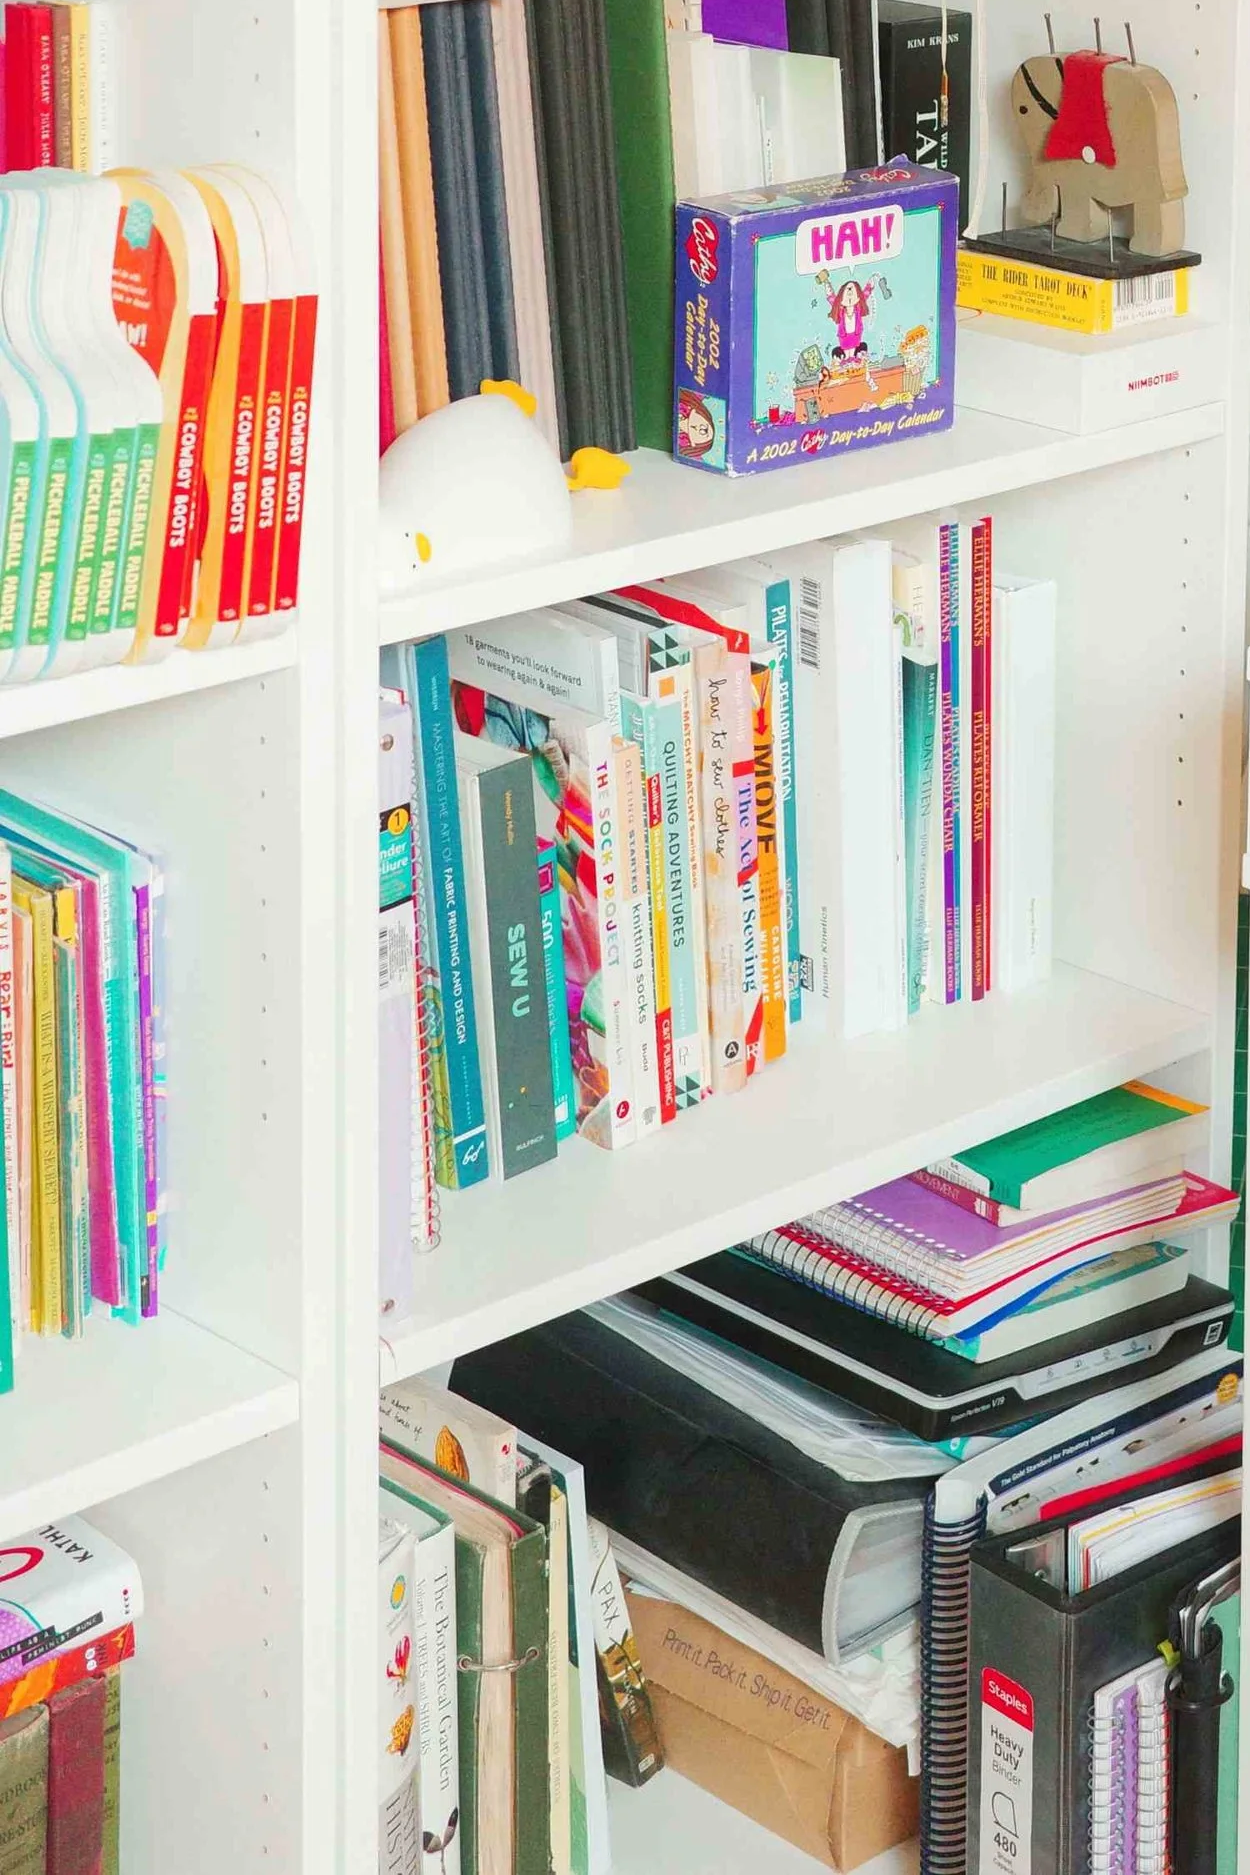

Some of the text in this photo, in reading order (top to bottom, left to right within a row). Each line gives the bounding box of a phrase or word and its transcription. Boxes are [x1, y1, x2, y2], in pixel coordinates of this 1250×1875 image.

[907, 37, 925, 50] KIM
[940, 131, 948, 169] WILD
[690, 217, 716, 287] Cathy
[811, 212, 895, 264] HAH!
[981, 263, 998, 280] THE
[1003, 267, 1029, 288] RIDER
[1033, 276, 1062, 295] TAROT
[1066, 283, 1089, 300] DECK
[684, 299, 696, 372] Calendar
[693, 292, 709, 388] Day-to-Day
[709, 317, 720, 371] 2002
[746, 407, 945, 465] A 2002 Day-to-Day Calendar
[169, 422, 198, 549] COWBOY BOOTS
[229, 409, 254, 535] COWBOY BOOTS
[5, 476, 31, 571] PICKLEBALL
[32, 472, 68, 630] PICKLEBALL PADDLE
[464, 634, 582, 687] 18 garments you'll look forward
[769, 603, 789, 665] PILATES
[477, 655, 486, 666] to
[486, 660, 517, 680] wearing
[517, 670, 539, 686] again
[538, 680, 546, 689] &
[940, 531, 955, 853] ELLIE HERMAN'S PILATES WUNDA CHAIR
[432, 722, 447, 792] MASTERING
[682, 711, 695, 823] MATCHY MATCHY
[708, 678, 731, 860] how to sew clothes
[393, 811, 400, 826] 1
[438, 792, 448, 817] THE
[738, 782, 751, 829] The
[754, 744, 777, 855] MOVE
[973, 766, 984, 843] REFORMER
[440, 821, 451, 842] ART
[662, 740, 686, 948] QUILTING ADVENTURES
[443, 867, 457, 909] FABRIC
[598, 809, 621, 968] SOCK PROJECT
[623, 759, 648, 1025] GETTING STARTED knitting socks
[742, 879, 756, 902] of
[449, 910, 460, 968] PRINTING
[742, 908, 760, 994] Sewing
[771, 925, 784, 1001] CAROLINE
[453, 971, 463, 996] AND
[507, 923, 530, 1018] SEW U
[456, 996, 466, 1045] DESIGN
[663, 1041, 675, 1107] PUBLISHING
[40, 1009, 59, 1206] WHAT IS WHISPERY SECRET?
[1012, 1470, 1026, 1483] Gold
[1026, 1456, 1050, 1475] Standard
[1050, 1452, 1061, 1464] for
[39, 1524, 94, 1563] KATHL
[597, 1578, 622, 1629] PAX
[27, 1632, 71, 1660] FEMINIST
[417, 1634, 426, 1678] TREES
[434, 1616, 453, 1792] Botanical Garden
[662, 1628, 692, 1661] Print
[705, 1650, 737, 1684] Pack
[750, 1674, 781, 1708] Ship
[794, 1696, 821, 1725] Get
[987, 1680, 1028, 1715] Staples
[990, 1724, 1024, 1758] Heavy
[993, 1741, 1020, 1771] Duty
[992, 1759, 1022, 1786] Binder
[993, 1832, 1018, 1858] 480
